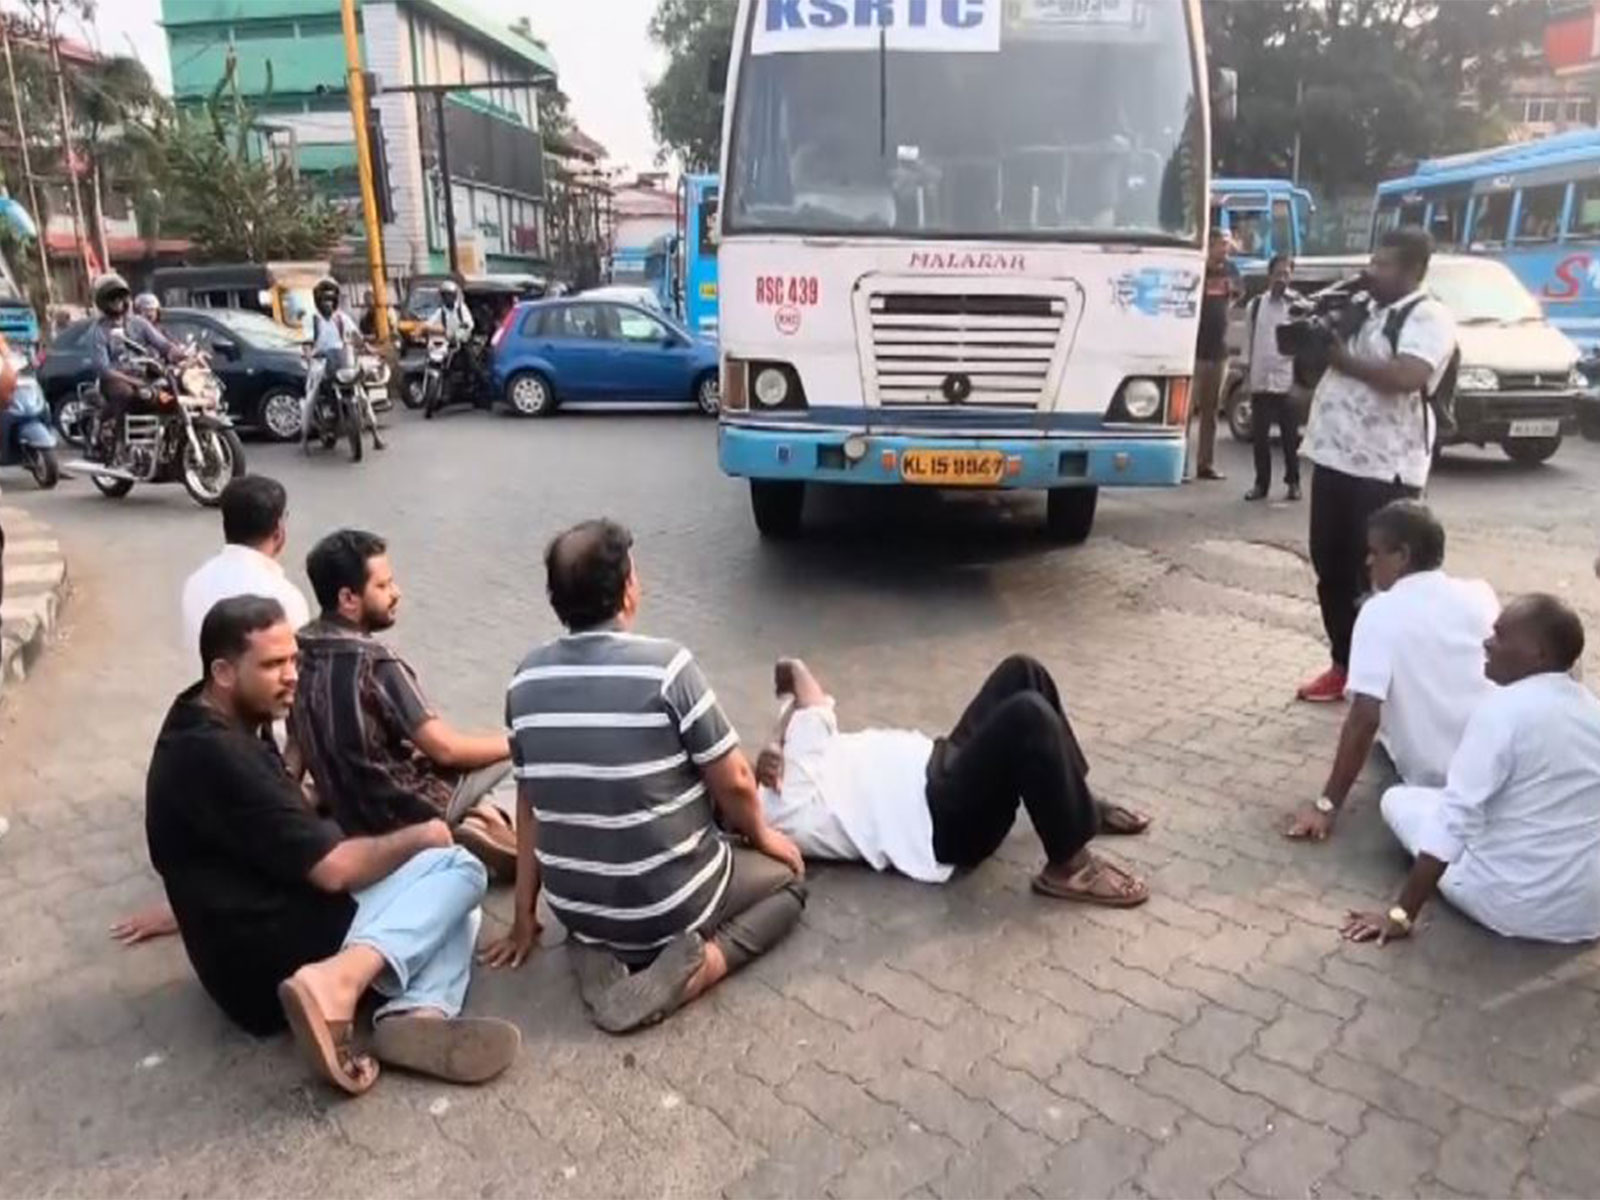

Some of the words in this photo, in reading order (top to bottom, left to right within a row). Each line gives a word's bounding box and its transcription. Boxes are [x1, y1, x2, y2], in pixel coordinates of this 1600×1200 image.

[765, 0, 984, 31] KSRTC
[756, 276, 784, 305] RSC
[788, 276, 818, 305] 439
[903, 455, 927, 475] KL
[931, 456, 949, 475] 15
